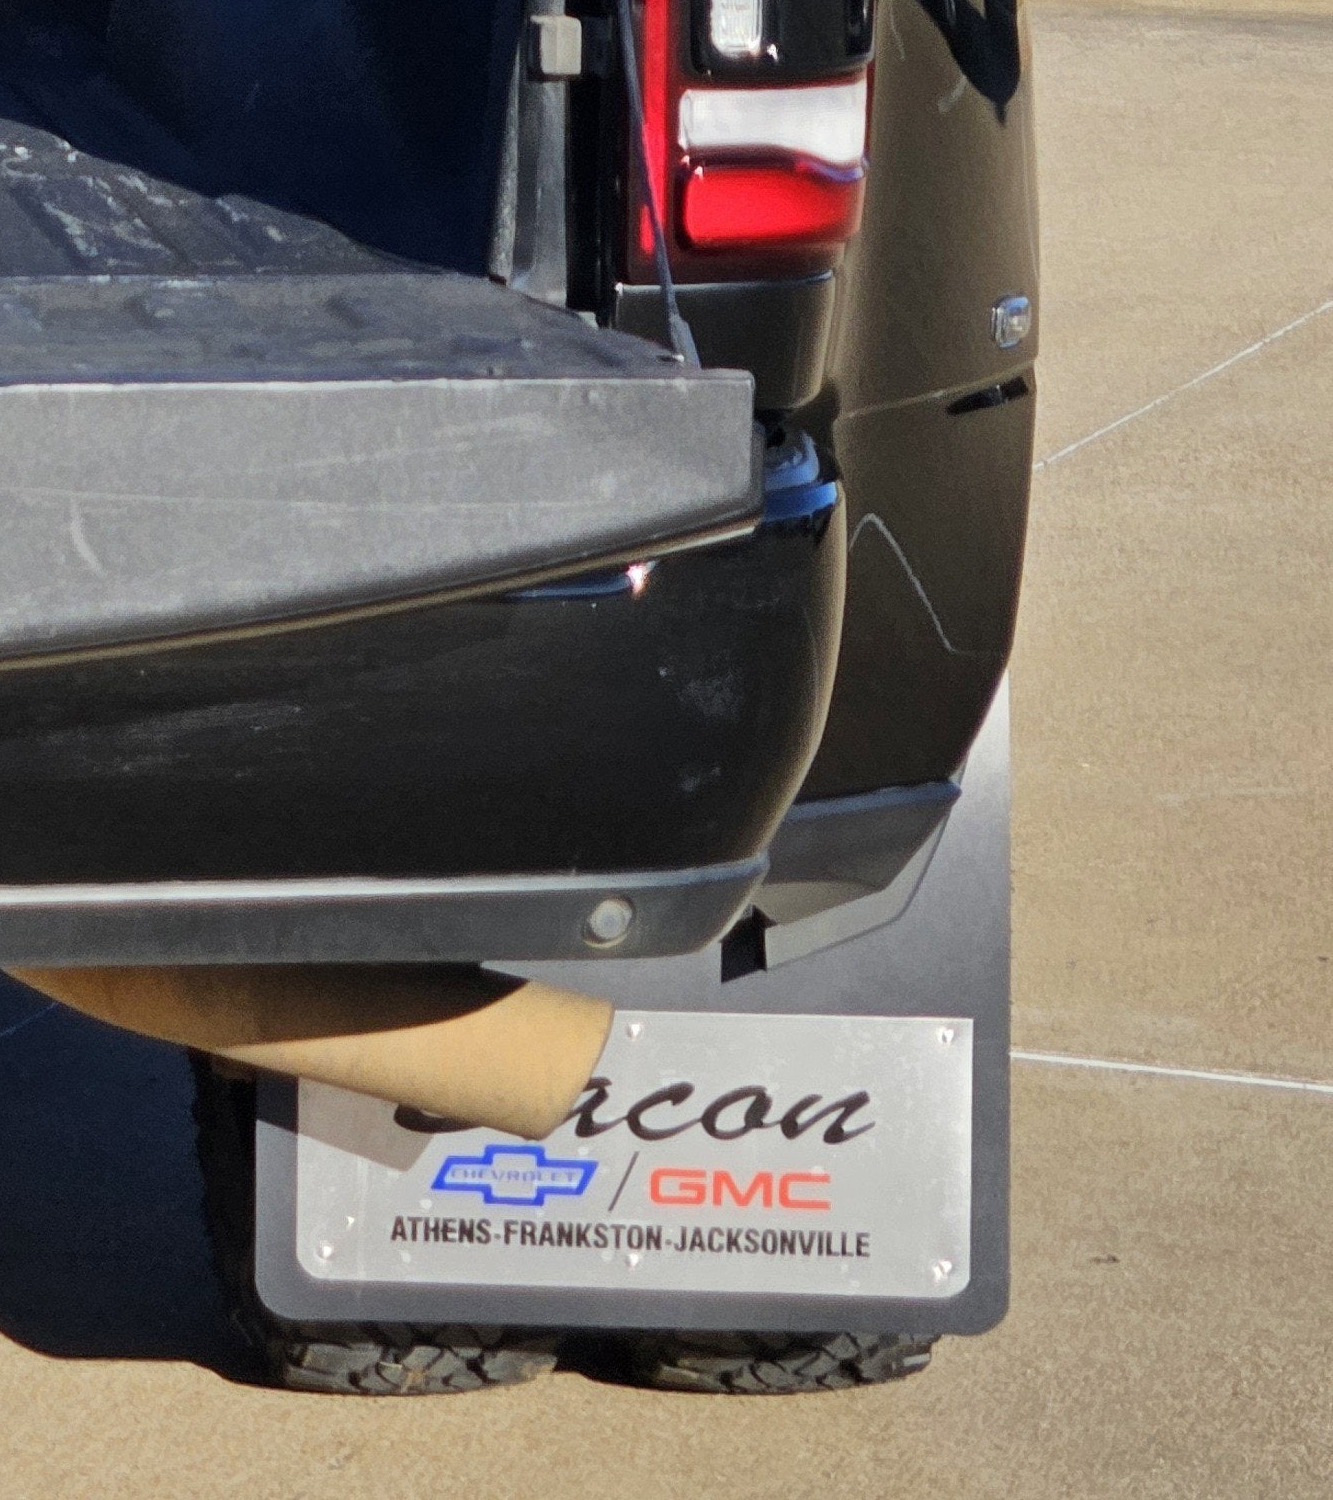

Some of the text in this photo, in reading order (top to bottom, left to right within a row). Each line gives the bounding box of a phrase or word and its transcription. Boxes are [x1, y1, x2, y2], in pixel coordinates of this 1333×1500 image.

[393, 1075, 876, 1145] acon
[649, 1167, 832, 1211] GMC
[390, 1214, 872, 1259] ATHENS-FRANKSTON-JACKSONVILLE
